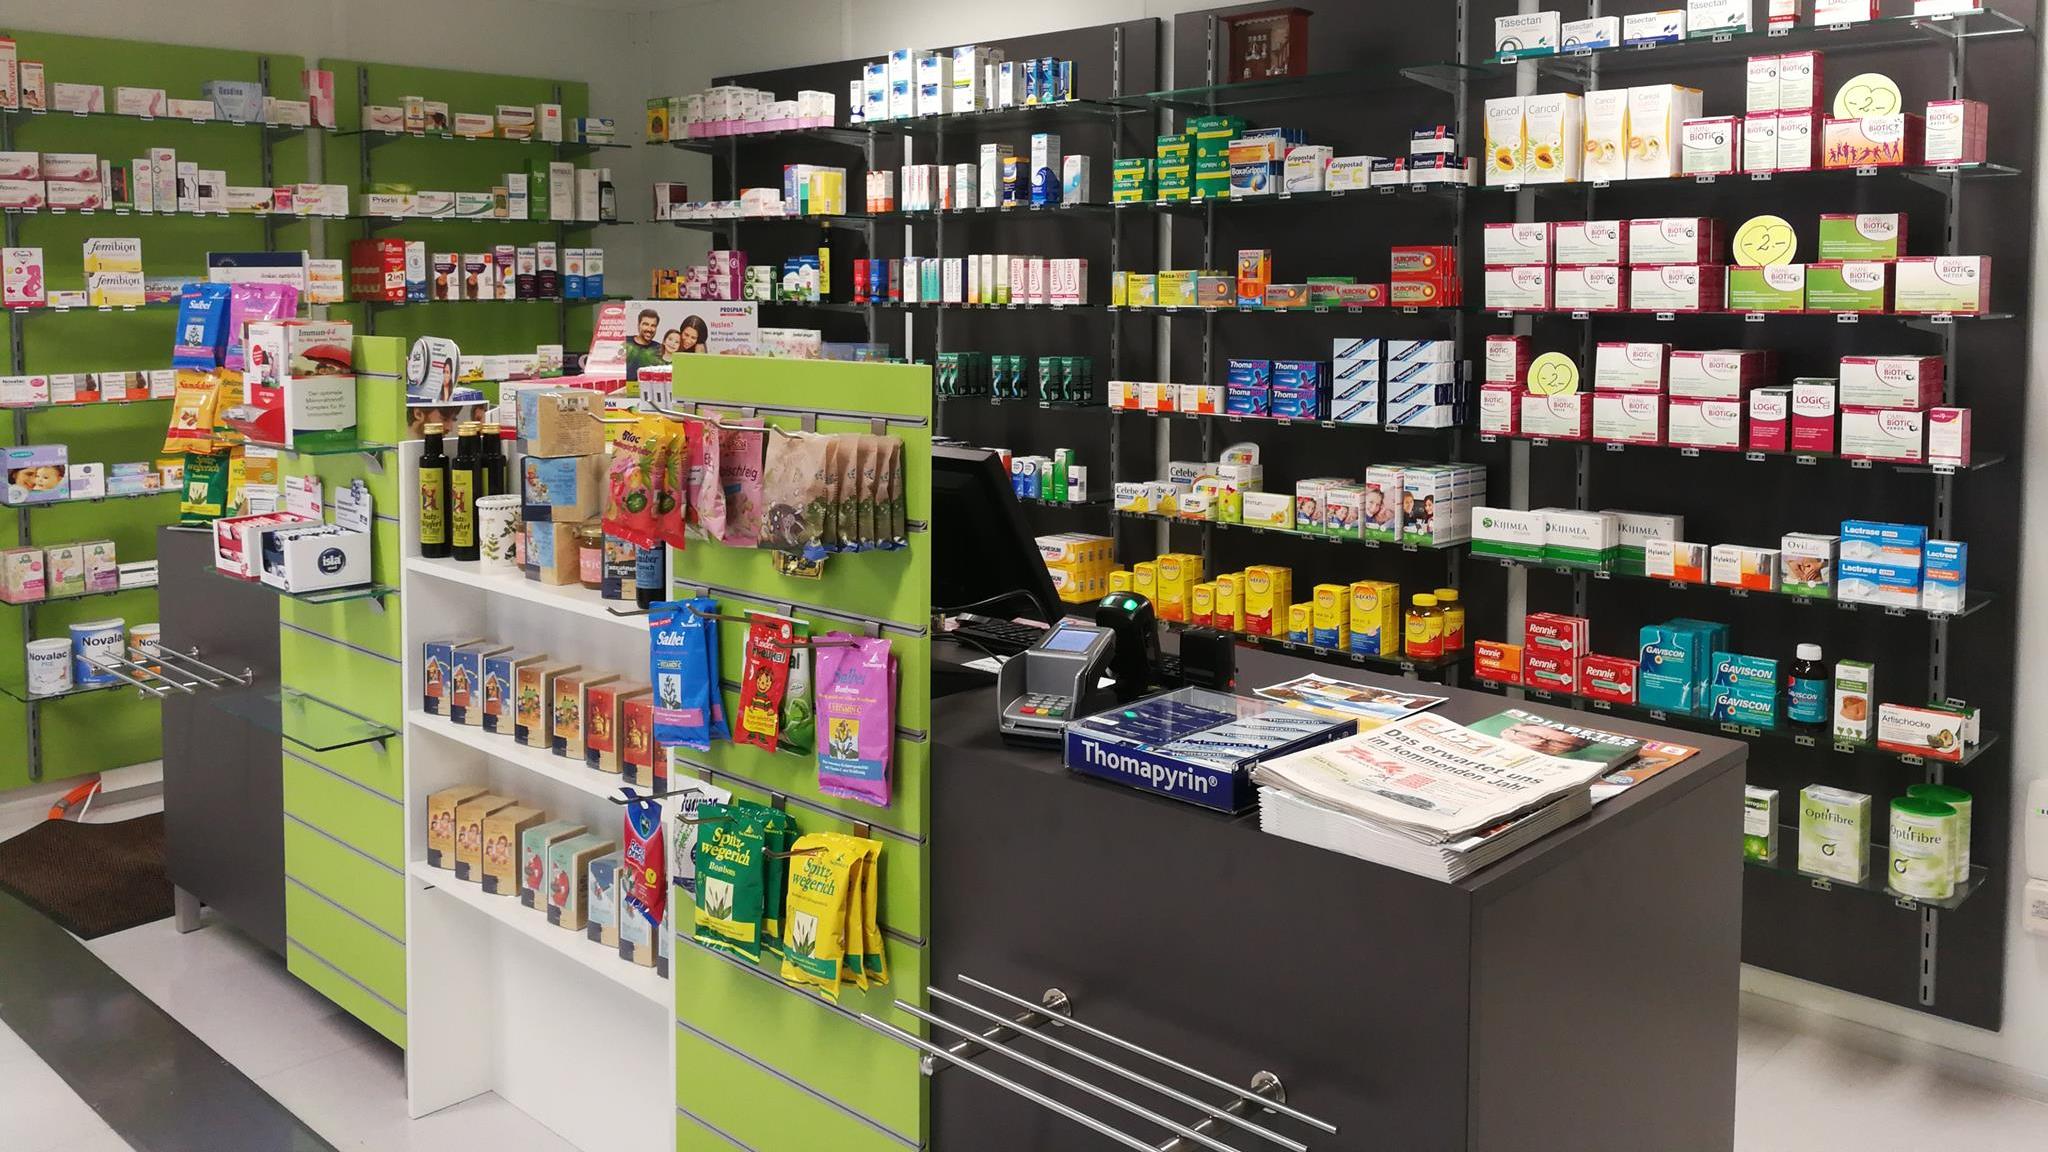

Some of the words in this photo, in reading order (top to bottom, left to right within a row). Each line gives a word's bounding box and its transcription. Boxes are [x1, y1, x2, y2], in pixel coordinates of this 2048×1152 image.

[1500, 15, 1541, 28] Tasectan
[1564, 21, 1594, 32] Tasectan
[1626, 15, 1656, 25] Tasectan
[1594, 96, 1616, 105] Caricol
[1638, 92, 1660, 101] Caricol
[1489, 105, 1520, 118] Caricol
[1528, 103, 1560, 115] Caricol
[1287, 153, 1315, 163] Grippostad
[1331, 161, 1363, 170] Grippostad
[88, 240, 136, 254] femibion
[93, 274, 140, 289] femibion
[1796, 395, 1825, 404] LOGiC
[1494, 519, 1528, 531] KIJIMEA
[1552, 524, 1587, 535] KIJIMEA
[1622, 525, 1658, 536] KIJIMEA
[1845, 526, 1880, 535] Lactrase
[1926, 550, 1957, 559] Lactrase
[1842, 564, 1877, 574] Lactrase
[1530, 624, 1557, 637] Rennie
[656, 630, 685, 646] Salbei
[29, 652, 67, 662] Novalac
[1478, 647, 1501, 658] Rennie
[1646, 645, 1685, 659] GAVISCON
[1530, 658, 1557, 670] Rennie
[1586, 666, 1616, 680] Rennie
[1720, 663, 1773, 679] GAVISCON
[1718, 695, 1771, 712] GAVISCON
[1881, 714, 1931, 729] Artischocke
[1526, 714, 1639, 745] DIABETES
[1367, 735, 1387, 748] im
[1389, 745, 1486, 783] kommenden
[1487, 777, 1529, 792] Jahr
[1384, 728, 1417, 747] Das
[1421, 743, 1501, 776] erwartet
[1507, 772, 1544, 786] uns
[1805, 807, 1854, 826] OptiFibre
[1890, 826, 1942, 845] OptiFibre
[701, 842, 750, 866] wegerich
[709, 861, 736, 876] Bonbons
[792, 873, 835, 896] wegerich
